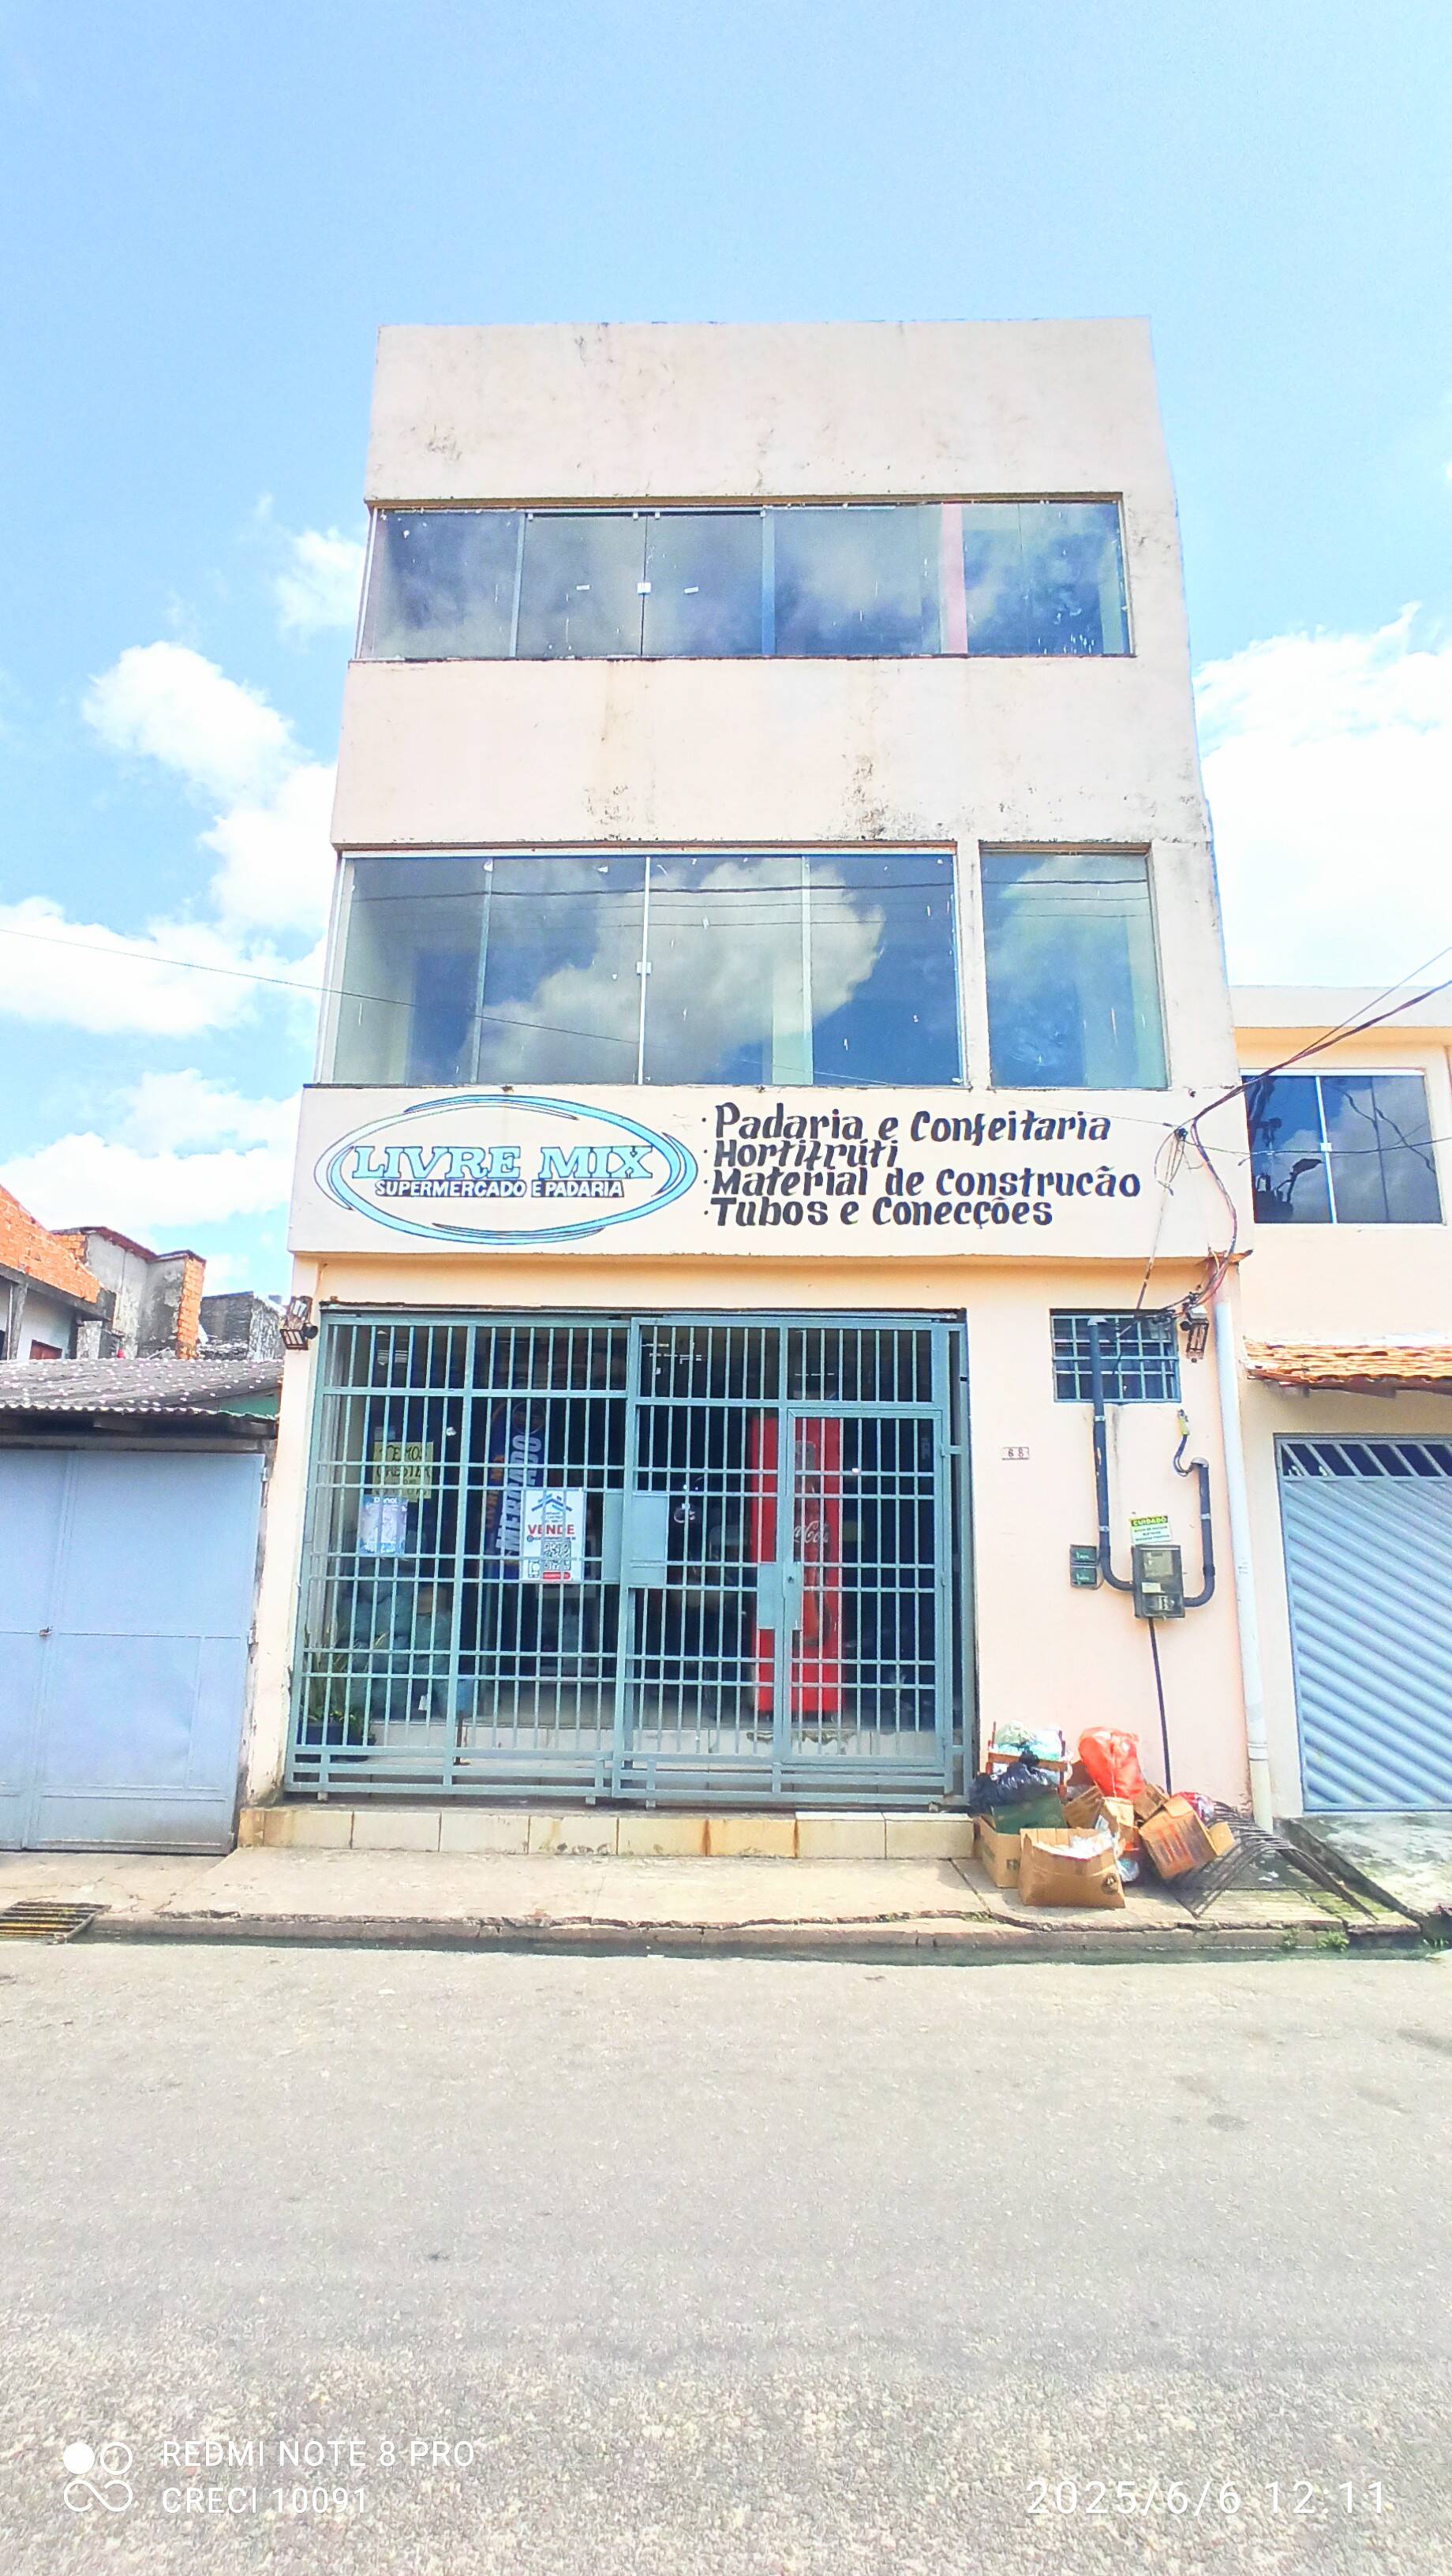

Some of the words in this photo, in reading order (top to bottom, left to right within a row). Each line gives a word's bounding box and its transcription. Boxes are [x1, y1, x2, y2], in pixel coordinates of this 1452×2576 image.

[715, 1102, 864, 1140] Padaria
[878, 1114, 899, 1140] e
[911, 1110, 1111, 1146] Confeitaria
[352, 1146, 520, 1178] LIVRE
[538, 1146, 653, 1178] MIX
[376, 1180, 526, 1197] SUPERMERCADO
[533, 1181, 541, 1196] E
[545, 1181, 623, 1197] PADARIA
[712, 1166, 868, 1196] Material
[885, 1167, 924, 1196] de
[710, 1196, 829, 1226] Tubos
[840, 1201, 859, 1225] e
[872, 1196, 1053, 1230] Conecções
